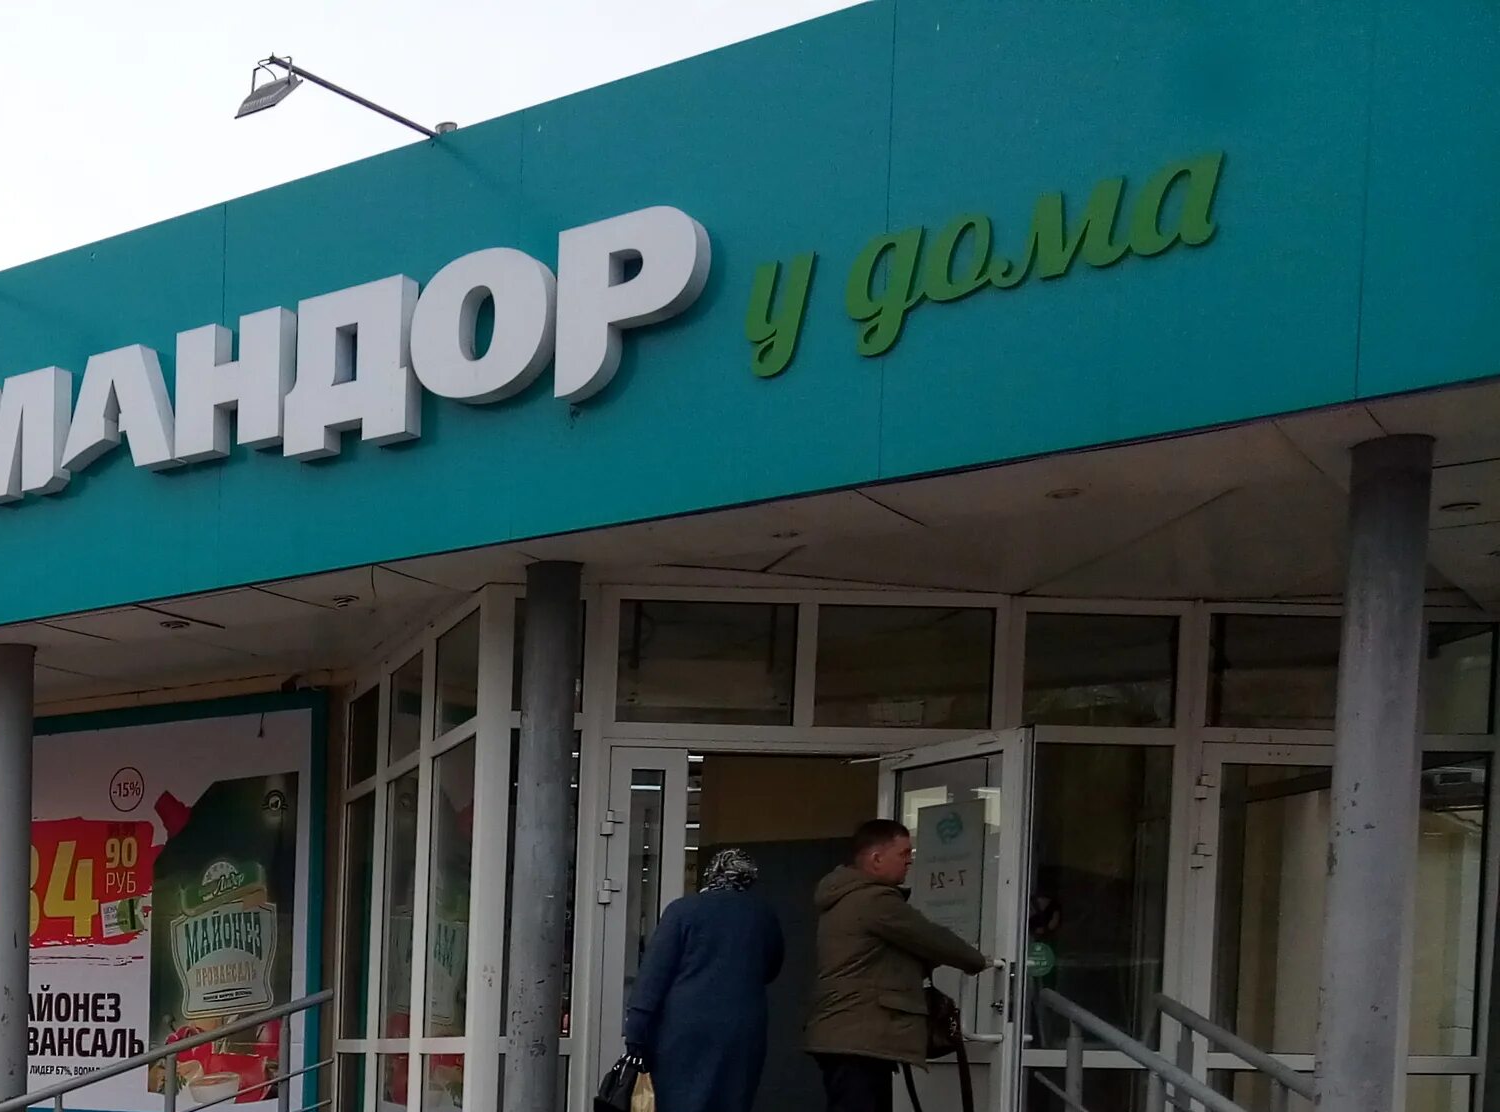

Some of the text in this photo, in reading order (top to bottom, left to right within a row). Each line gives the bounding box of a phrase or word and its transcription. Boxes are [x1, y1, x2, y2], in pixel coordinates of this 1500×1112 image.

[746, 252, 816, 378] у
[845, 151, 1223, 357] дома
[112, 781, 141, 798] -15%
[106, 837, 138, 868] 90
[106, 872, 136, 894] РУБ
[184, 910, 262, 972] МАЙОНЕЗ
[28, 984, 121, 1022] АЙОНЕЗ
[29, 1065, 54, 1075] ЛИДЕР
